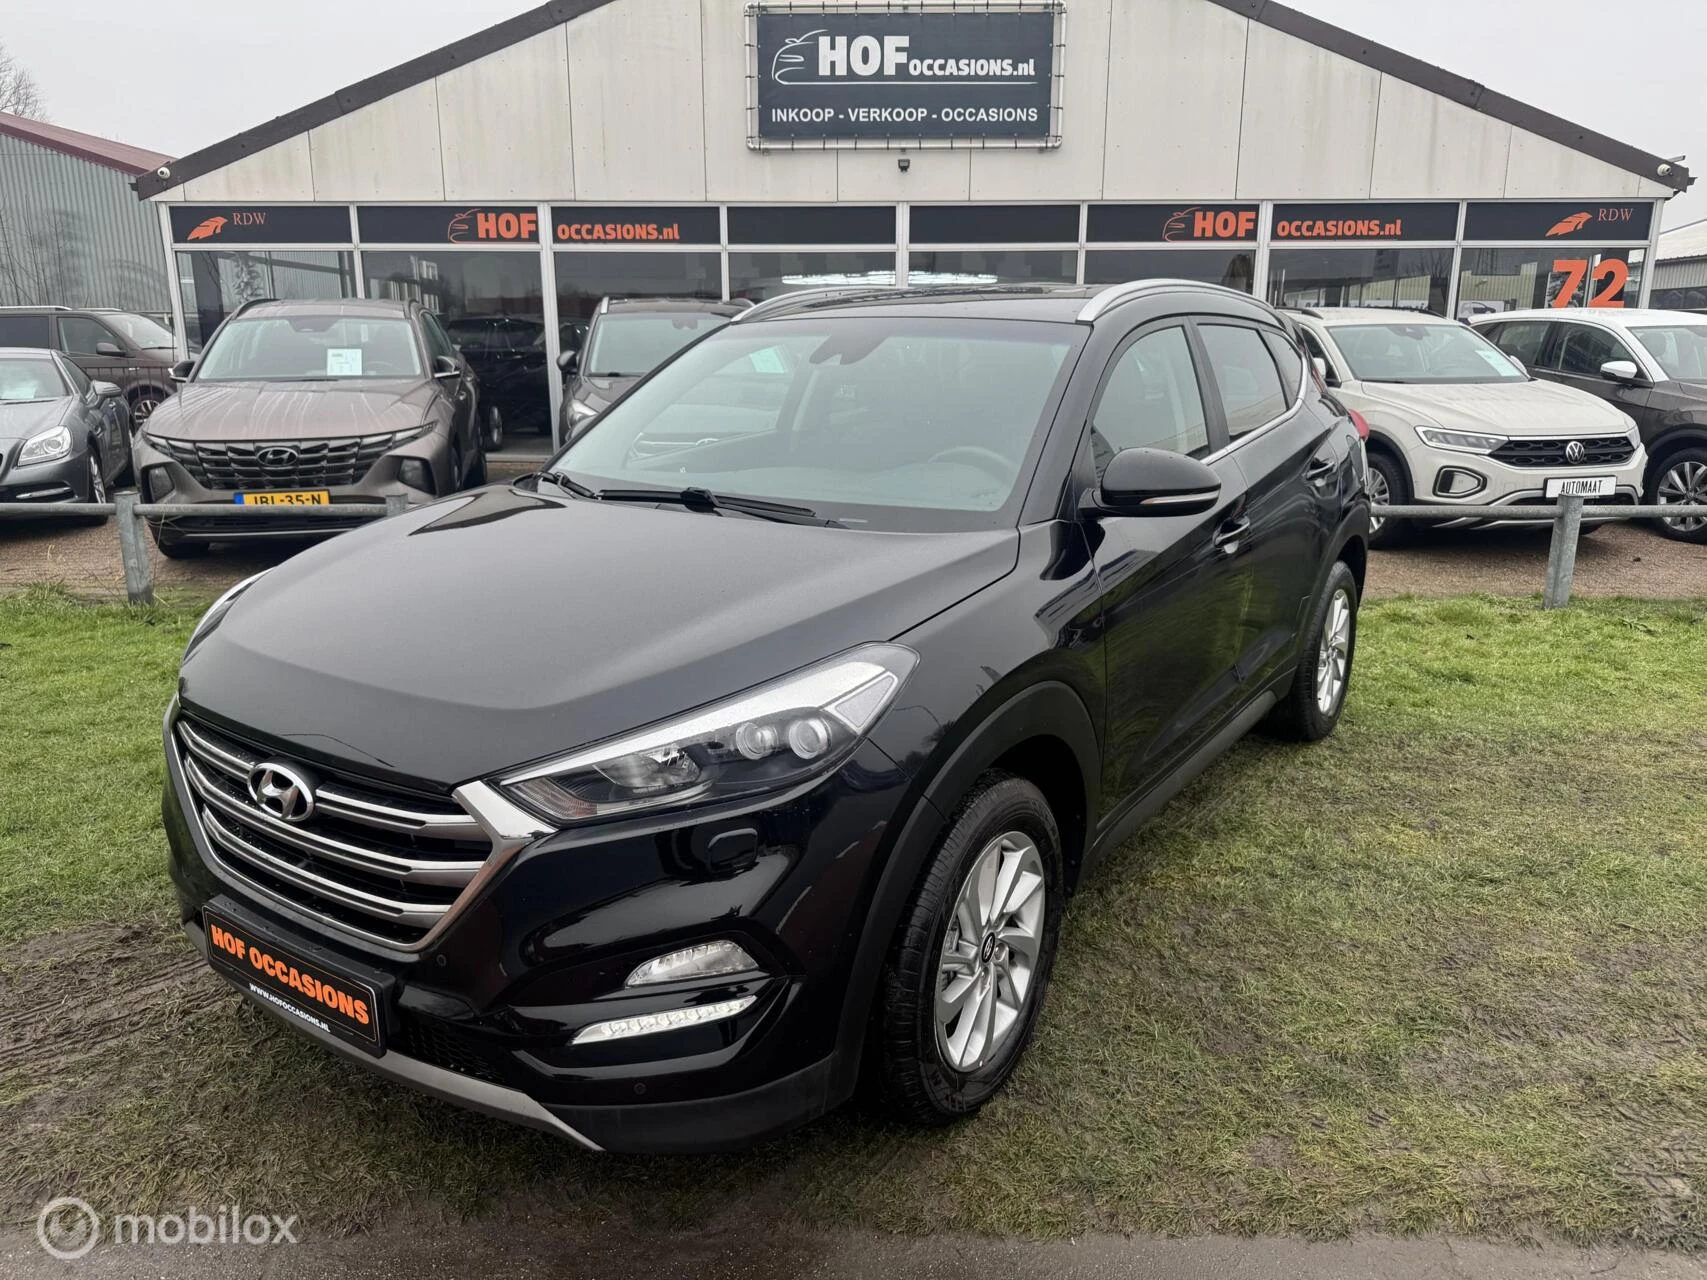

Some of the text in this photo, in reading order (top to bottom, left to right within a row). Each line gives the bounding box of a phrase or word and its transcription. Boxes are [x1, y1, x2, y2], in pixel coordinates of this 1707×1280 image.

[771, 108, 835, 123] INKOOP
[848, 108, 928, 122] VERKOOP
[941, 108, 1039, 122] OCCASIONS
[232, 212, 267, 226] RDW
[1193, 211, 1402, 238] HOF OCCASIONS.nl
[1598, 208, 1634, 222] RDW
[476, 213, 681, 240] HOF OCCASIONS.nl
[1551, 258, 1630, 309] 72
[1560, 480, 1603, 494] AUTOMAAT
[210, 924, 370, 1025] HOF OCCASIONS
